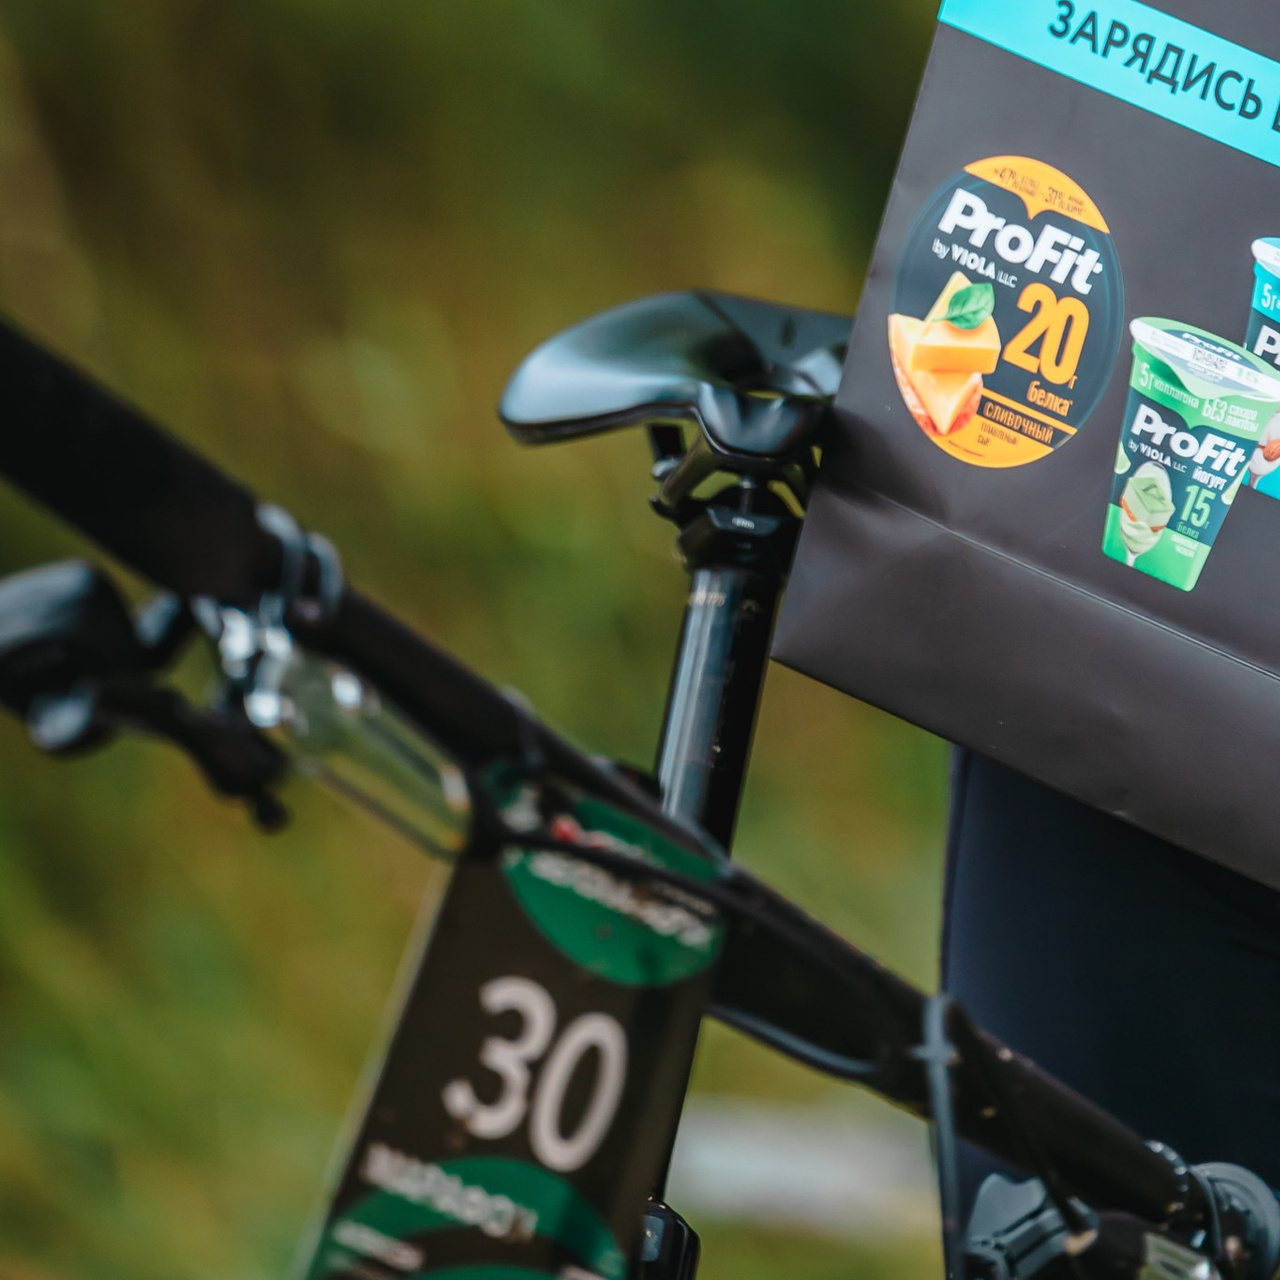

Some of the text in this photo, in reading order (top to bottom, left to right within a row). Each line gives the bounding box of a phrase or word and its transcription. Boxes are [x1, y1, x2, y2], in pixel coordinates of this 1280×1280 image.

[931, 238, 949, 259] by
[951, 243, 996, 280] VIOLA
[937, 187, 1103, 295] ProFit
[1002, 282, 1090, 385] 20
[983, 401, 1054, 444] СЛИВОЧНЫЙ
[1130, 403, 1246, 477] ProFit
[1140, 442, 1171, 467] VIOLA
[1181, 484, 1217, 528] 15
[442, 975, 628, 1173] 30
